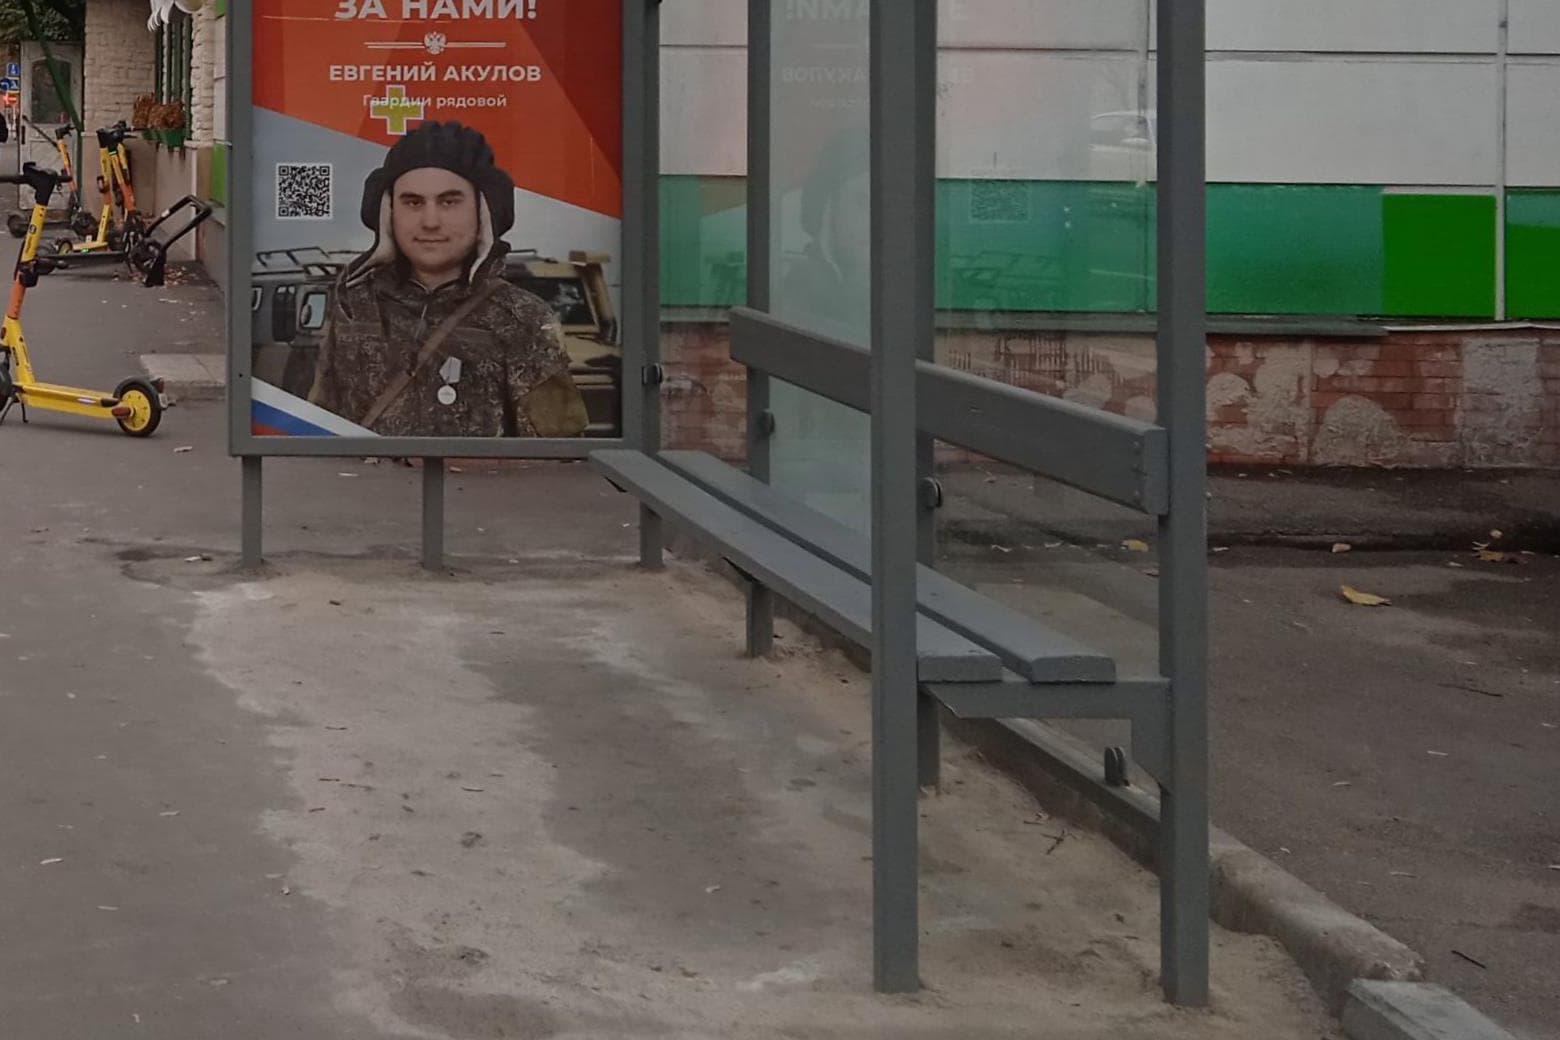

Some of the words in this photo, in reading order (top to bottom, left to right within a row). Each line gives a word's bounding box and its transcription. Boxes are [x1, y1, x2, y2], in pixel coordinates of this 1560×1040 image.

[329, 61, 436, 81] ЕВГЕНИЙ
[443, 64, 541, 82] АКУЛОВ
[362, 94, 431, 109] Гвардии
[437, 93, 507, 109] рядовой
